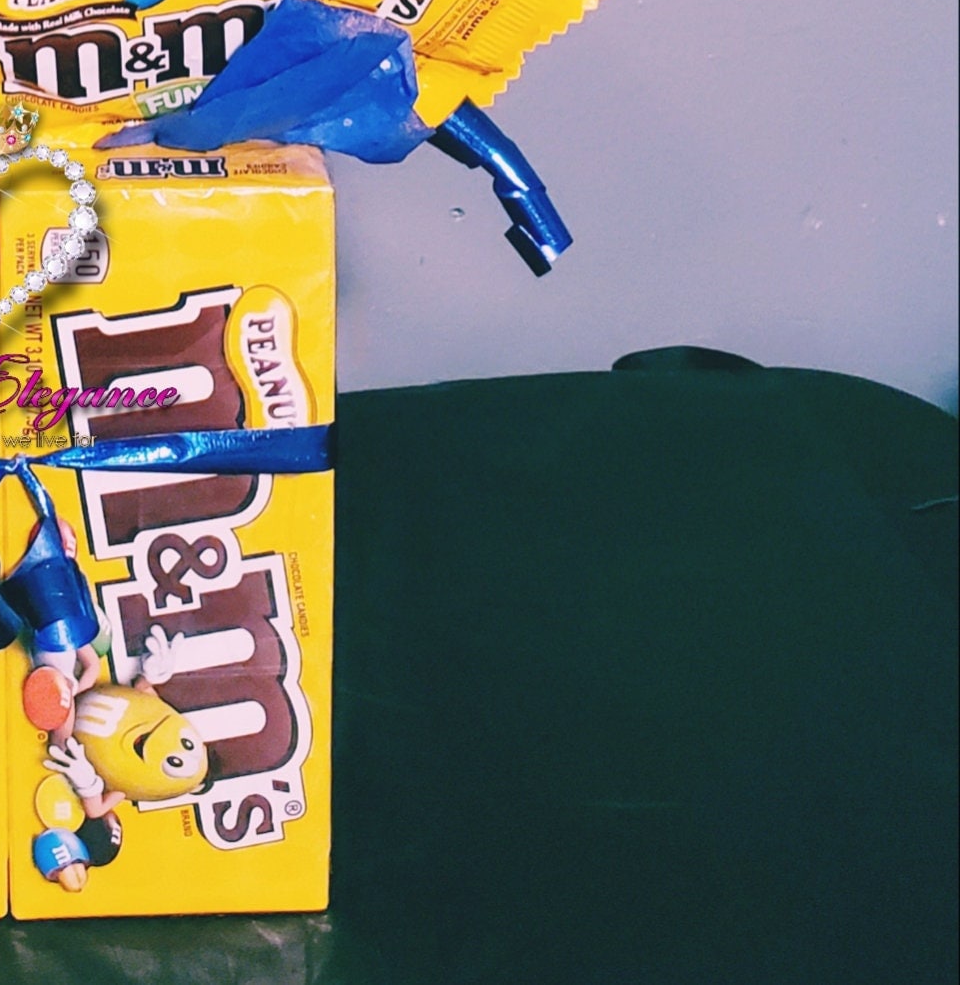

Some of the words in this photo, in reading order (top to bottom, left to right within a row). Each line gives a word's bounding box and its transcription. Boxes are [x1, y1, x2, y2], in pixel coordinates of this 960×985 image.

[20, 21, 41, 32] with
[42, 18, 63, 30] Real
[64, 11, 83, 24] Milk
[84, 5, 131, 18] Chocolate
[5, 94, 57, 109] CHOCOLATE
[60, 102, 100, 115] CANDIES
[144, 85, 205, 115] FUN
[15, 237, 25, 254] PER
[15, 255, 25, 276] PACK
[24, 295, 43, 320] NET
[24, 322, 43, 343] WT
[246, 315, 296, 428] PEANU
[289, 551, 304, 599] CHOCOLATE
[297, 601, 310, 637] CANDIES
[180, 808, 193, 837] BRAND
